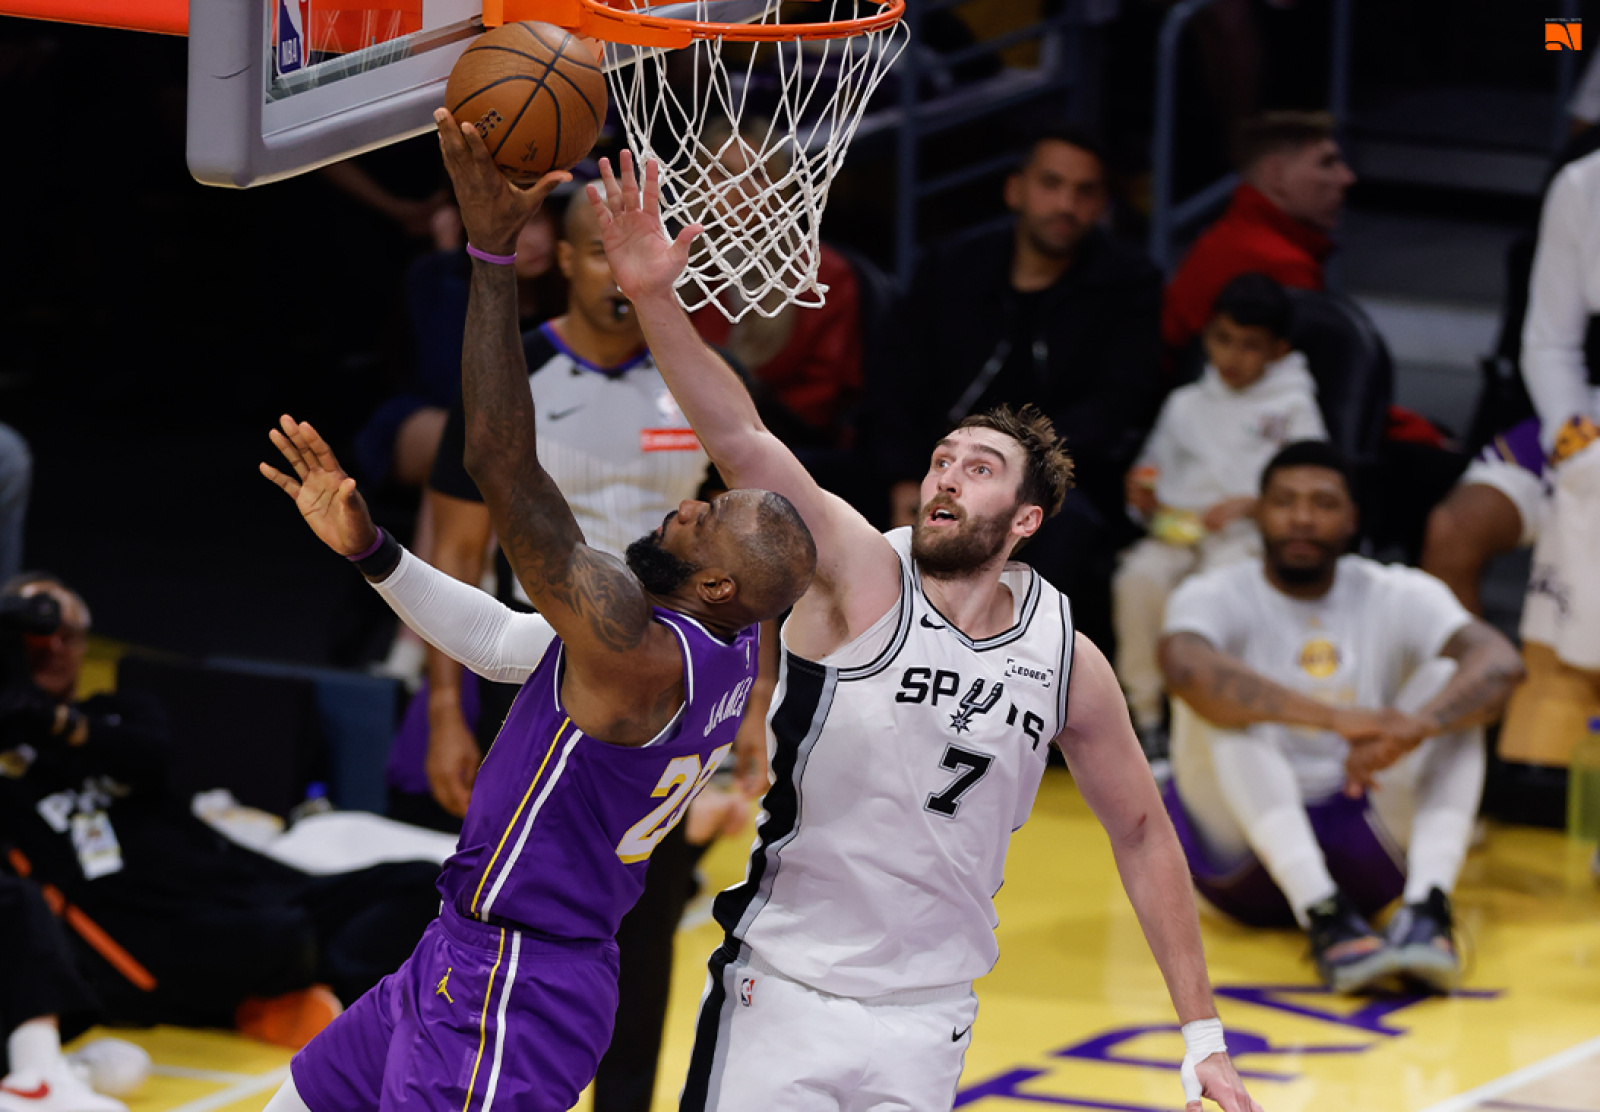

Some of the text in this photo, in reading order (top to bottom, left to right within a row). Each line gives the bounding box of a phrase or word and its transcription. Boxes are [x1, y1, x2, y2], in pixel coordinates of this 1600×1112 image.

[281, 37, 299, 67] NBA
[1011, 664, 1047, 682] LEDGER
[703, 676, 753, 738] JAMES
[923, 742, 996, 819] 7
